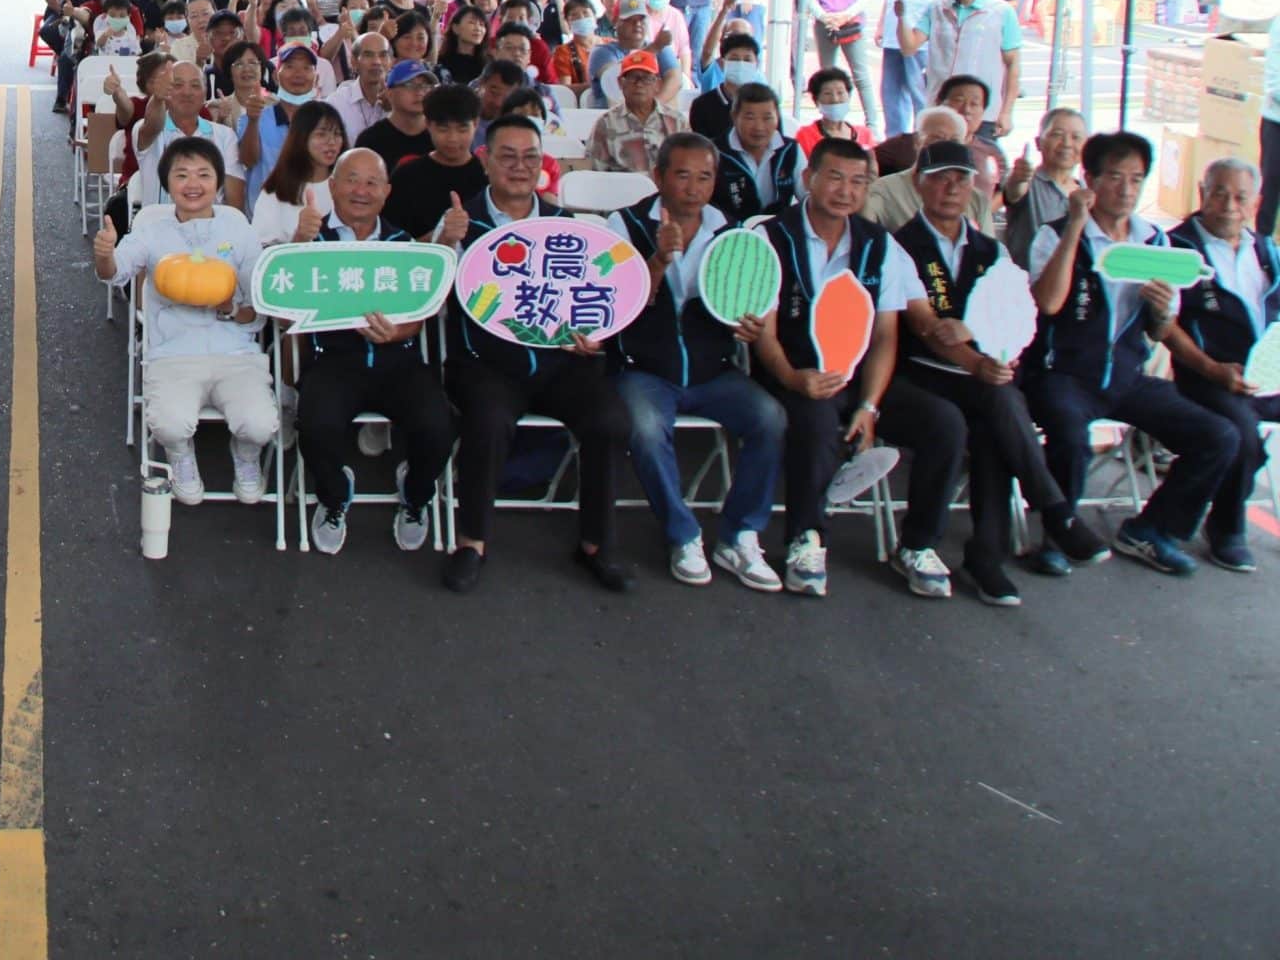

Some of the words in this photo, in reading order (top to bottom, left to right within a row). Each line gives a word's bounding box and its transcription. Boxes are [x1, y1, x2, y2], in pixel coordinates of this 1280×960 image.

[269, 266, 433, 294] 水上鄉農會
[513, 281, 615, 328] 教育
